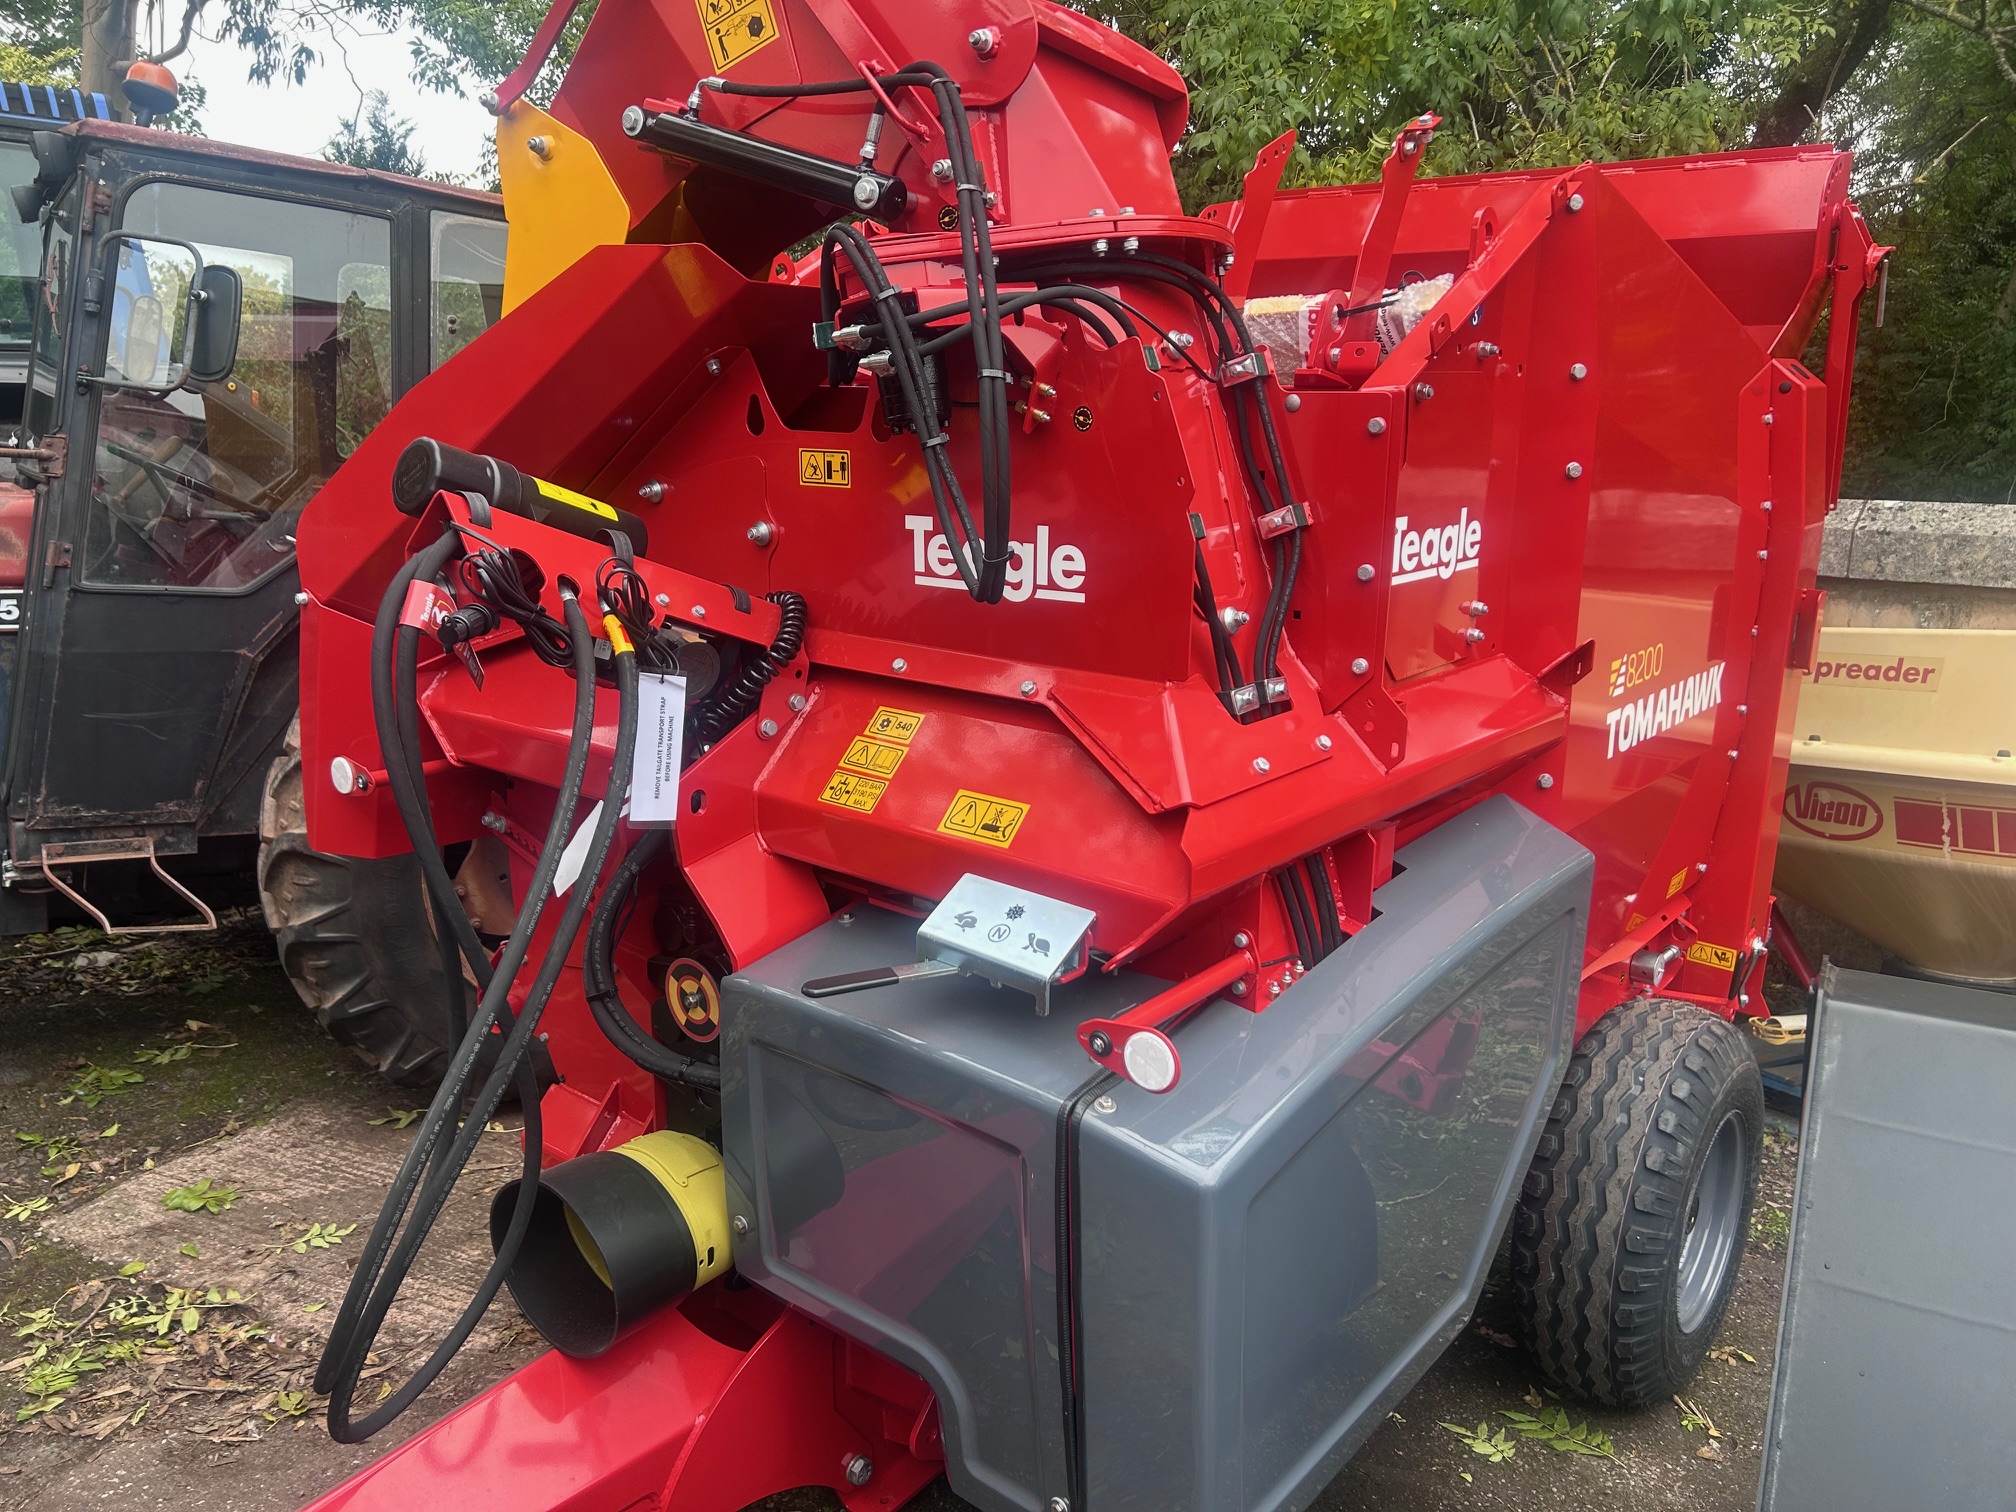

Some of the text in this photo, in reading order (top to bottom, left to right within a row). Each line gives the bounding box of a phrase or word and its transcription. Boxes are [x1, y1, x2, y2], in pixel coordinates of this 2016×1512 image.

[1375, 326, 1389, 355] GENU
[1392, 507, 1481, 580] Teagle
[1626, 643, 1663, 688] 8200
[1802, 657, 1936, 685] preader
[1606, 661, 1726, 760] TOMAHAWK
[657, 715, 665, 748] TRANSPORT
[895, 721, 913, 731] 540
[853, 788, 878, 801] 3190 PSI
[858, 780, 882, 790] 220 BAR
[853, 799, 867, 807] MAX
[1793, 784, 1867, 828] Vicon
